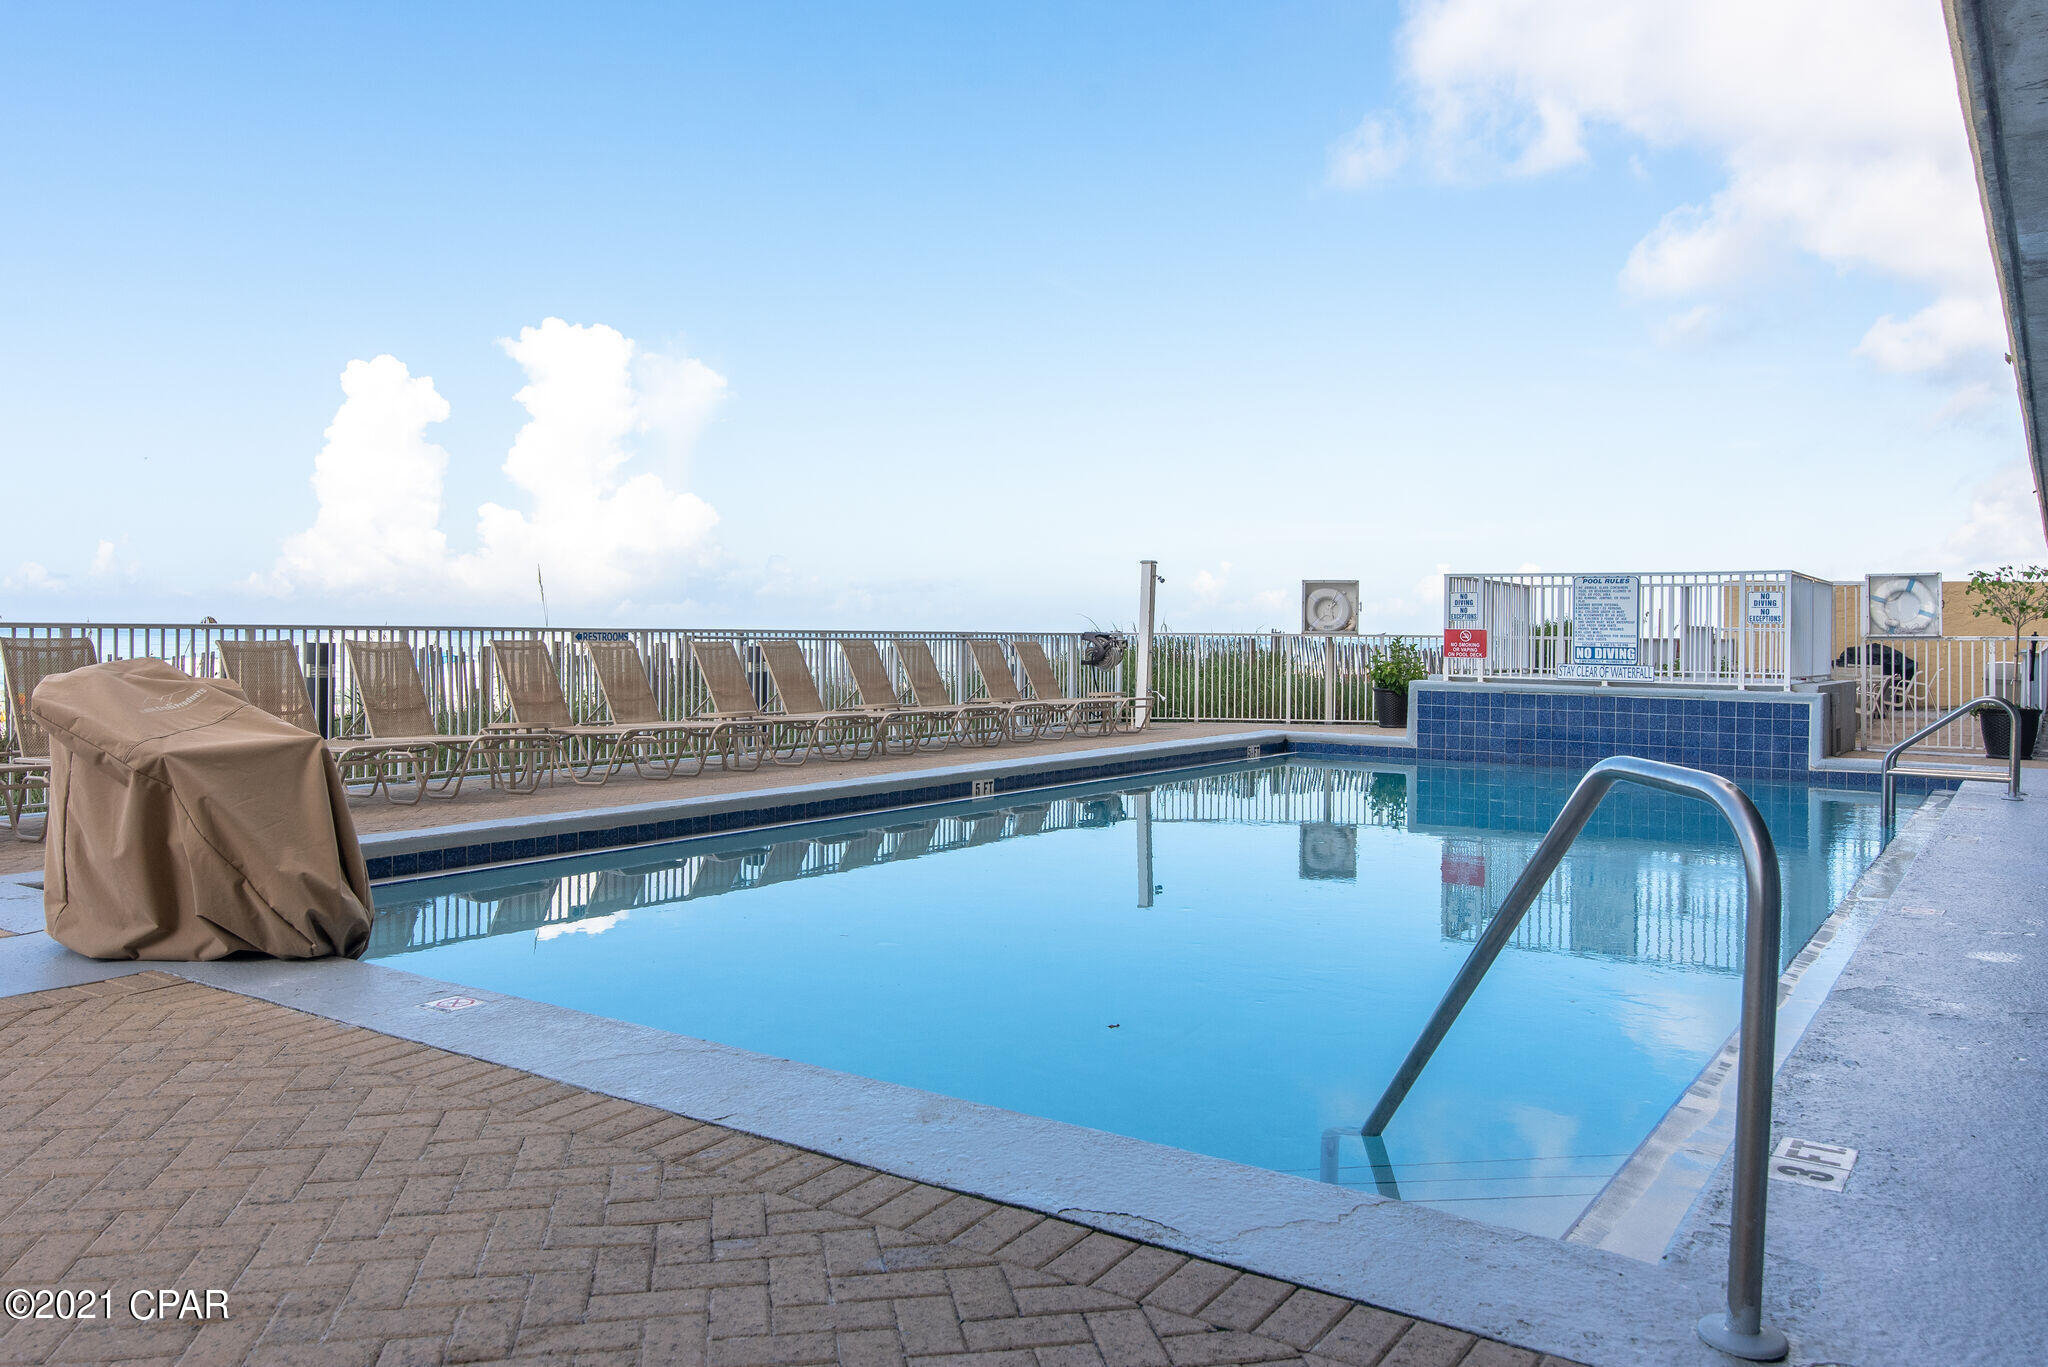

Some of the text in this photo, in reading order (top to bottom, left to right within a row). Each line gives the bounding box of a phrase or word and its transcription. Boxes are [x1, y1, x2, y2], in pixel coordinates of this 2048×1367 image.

[582, 632, 629, 641] RESTROOMS
[1576, 648, 1635, 660] NO DIVING
[1558, 666, 1653, 679] STAY CLEAR OF WATERFALL
[975, 781, 994, 797] 5 FT
[1777, 1166, 1834, 1181] 3
